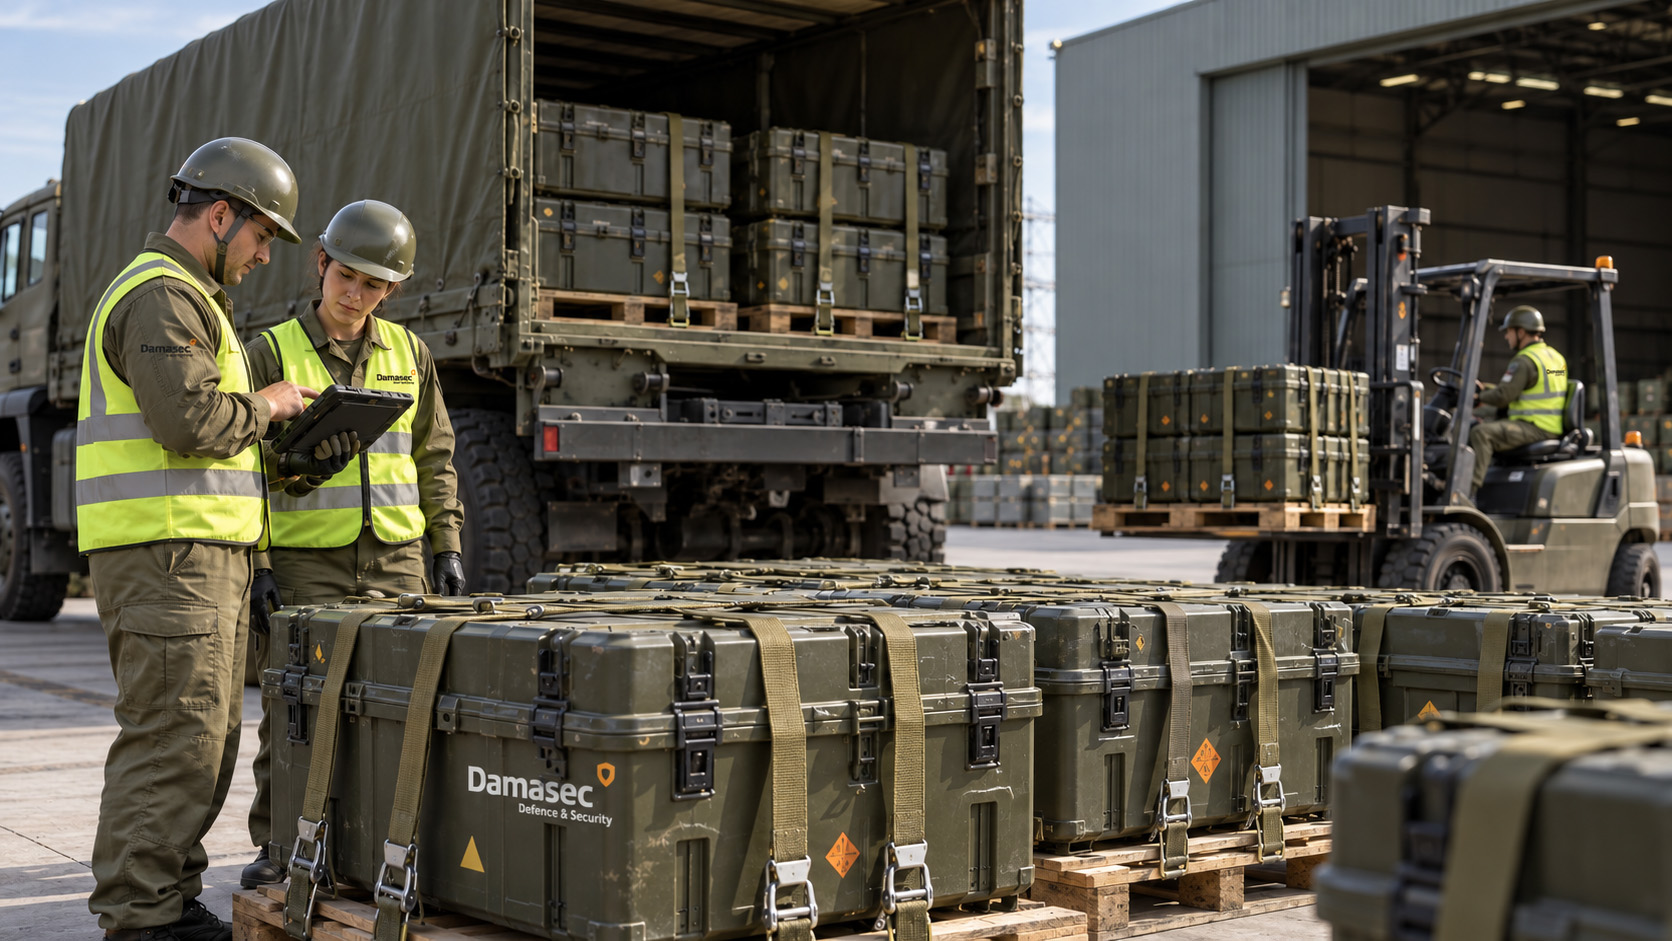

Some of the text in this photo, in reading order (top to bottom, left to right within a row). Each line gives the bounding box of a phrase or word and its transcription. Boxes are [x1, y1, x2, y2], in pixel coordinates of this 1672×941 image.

[140, 344, 192, 353] Damasec
[376, 373, 412, 381] Damasec
[467, 765, 594, 808] Damasec
[518, 803, 613, 828] Defence & Security
